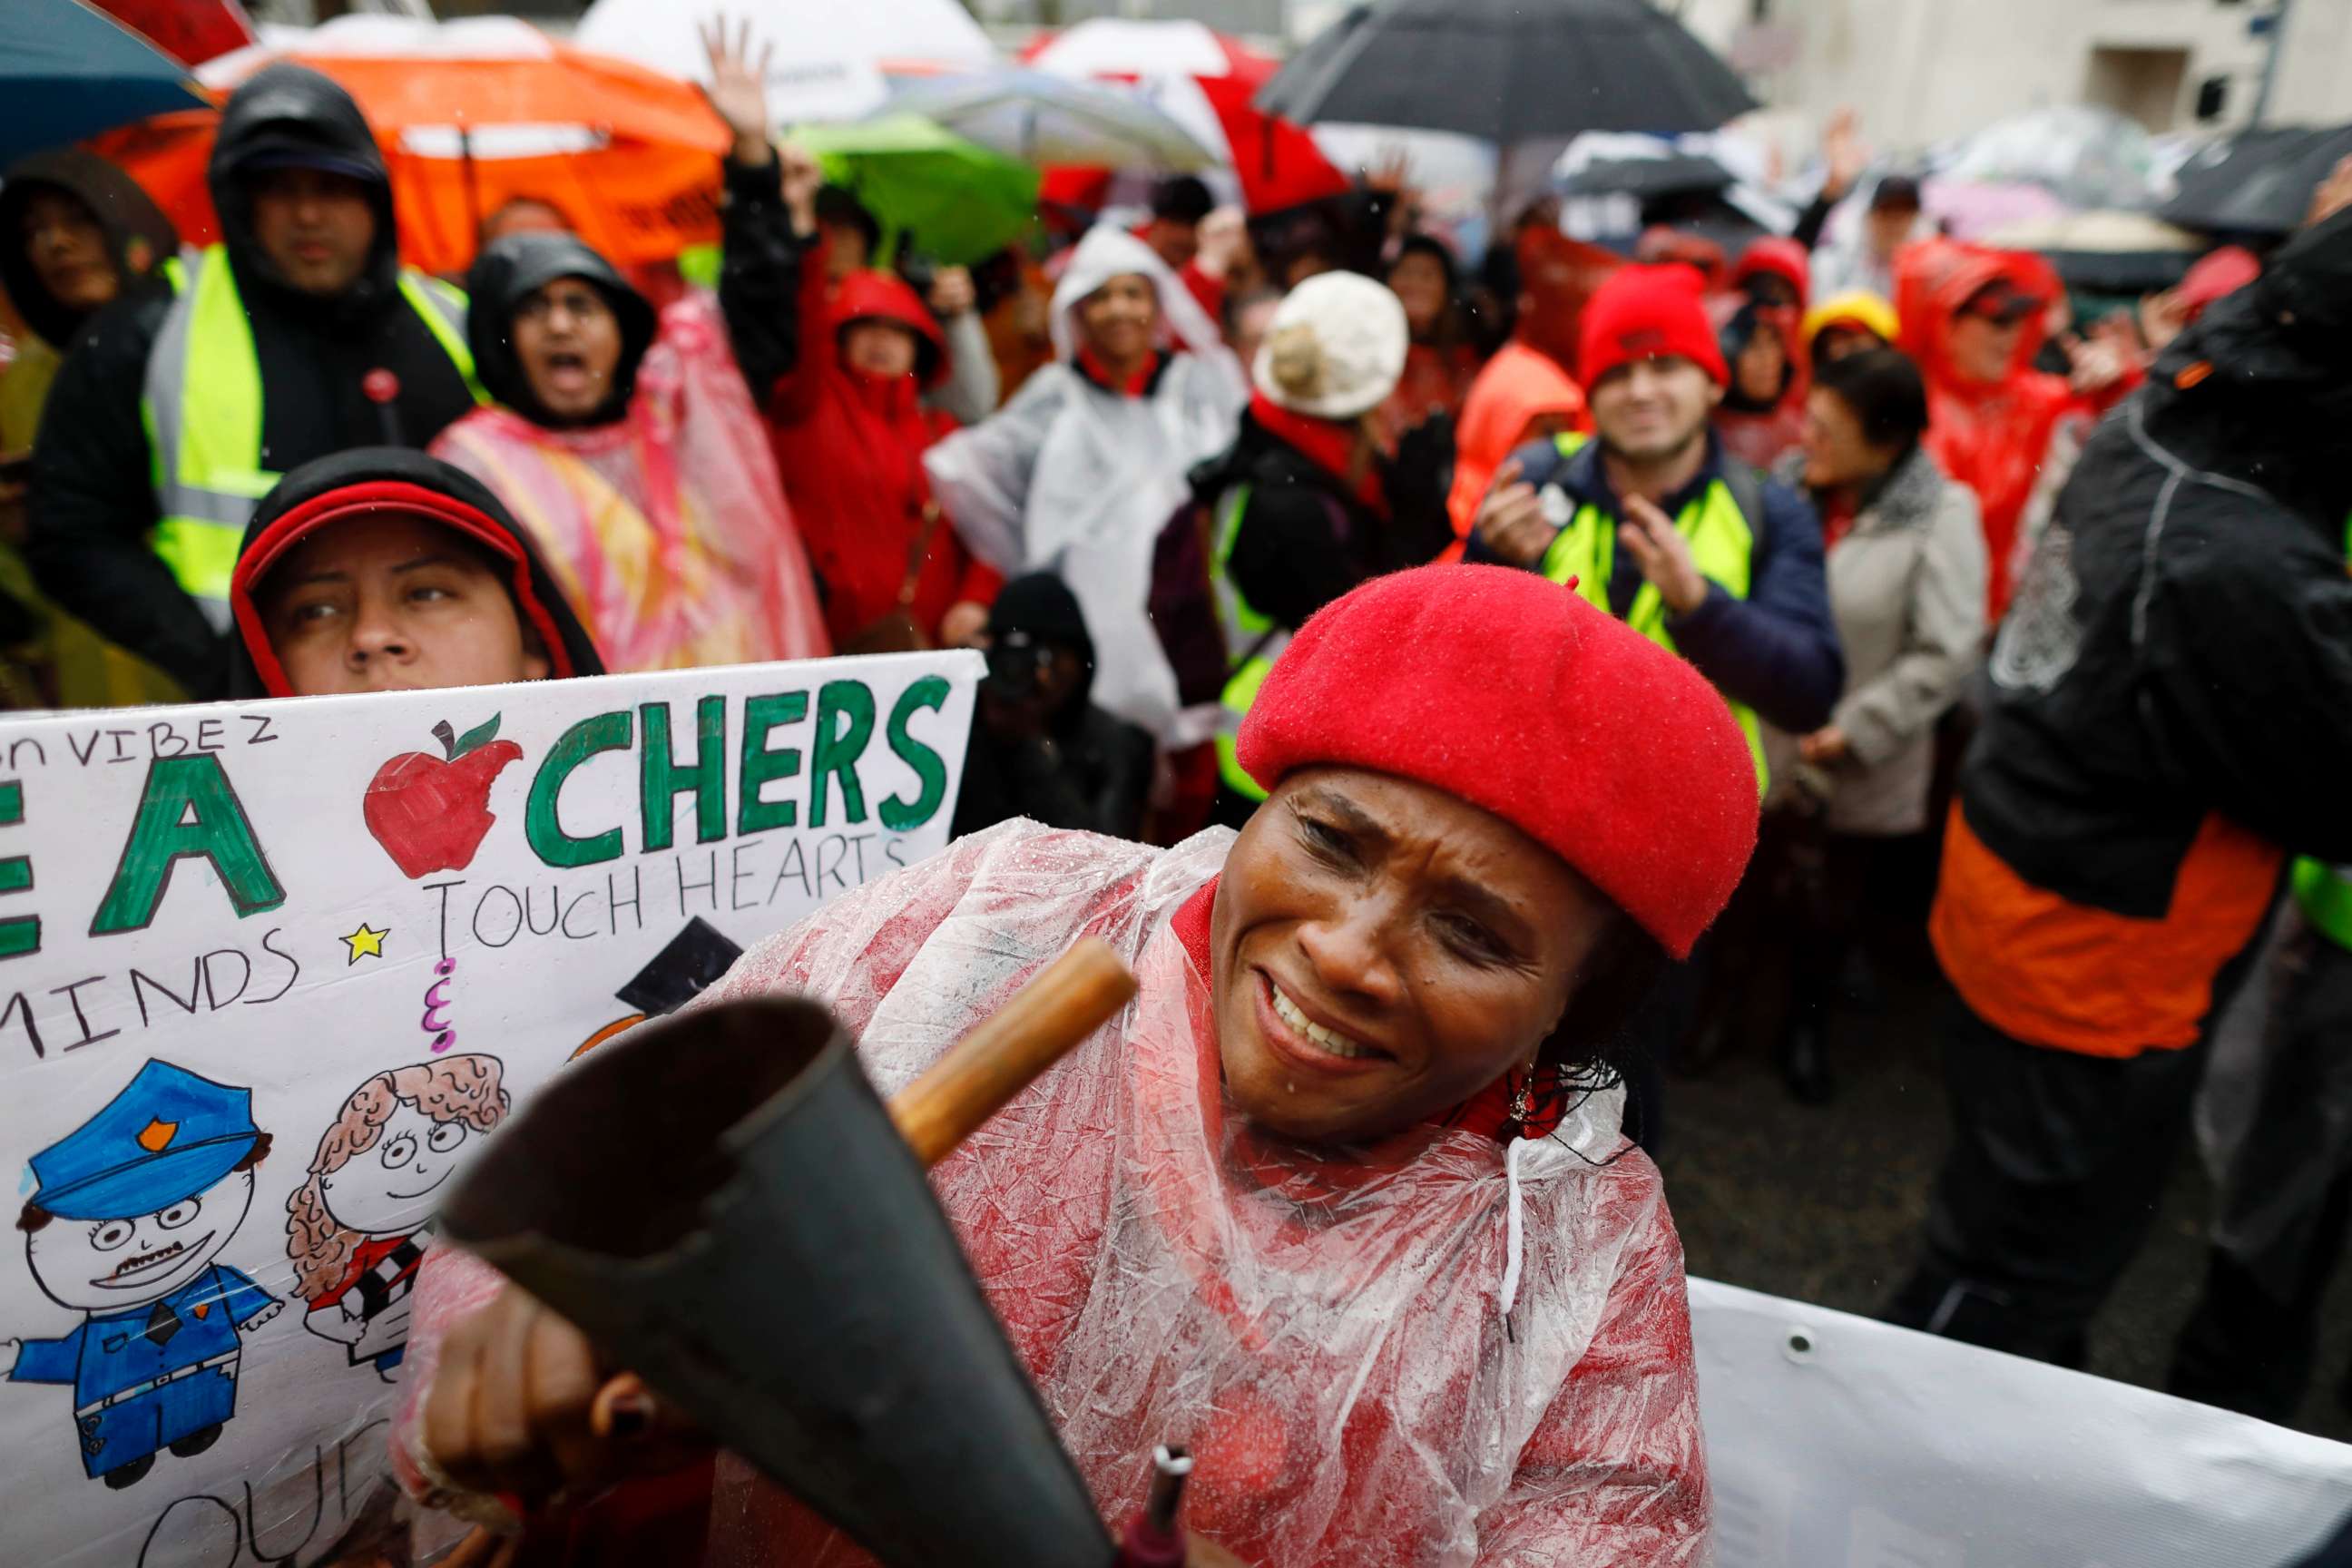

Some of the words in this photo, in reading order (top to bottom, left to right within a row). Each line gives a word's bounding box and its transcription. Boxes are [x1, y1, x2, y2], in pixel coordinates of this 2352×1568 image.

[67, 715, 278, 767] VIBEZ
[422, 864, 642, 960] TOUCH
[676, 833, 906, 916] HEARTS
